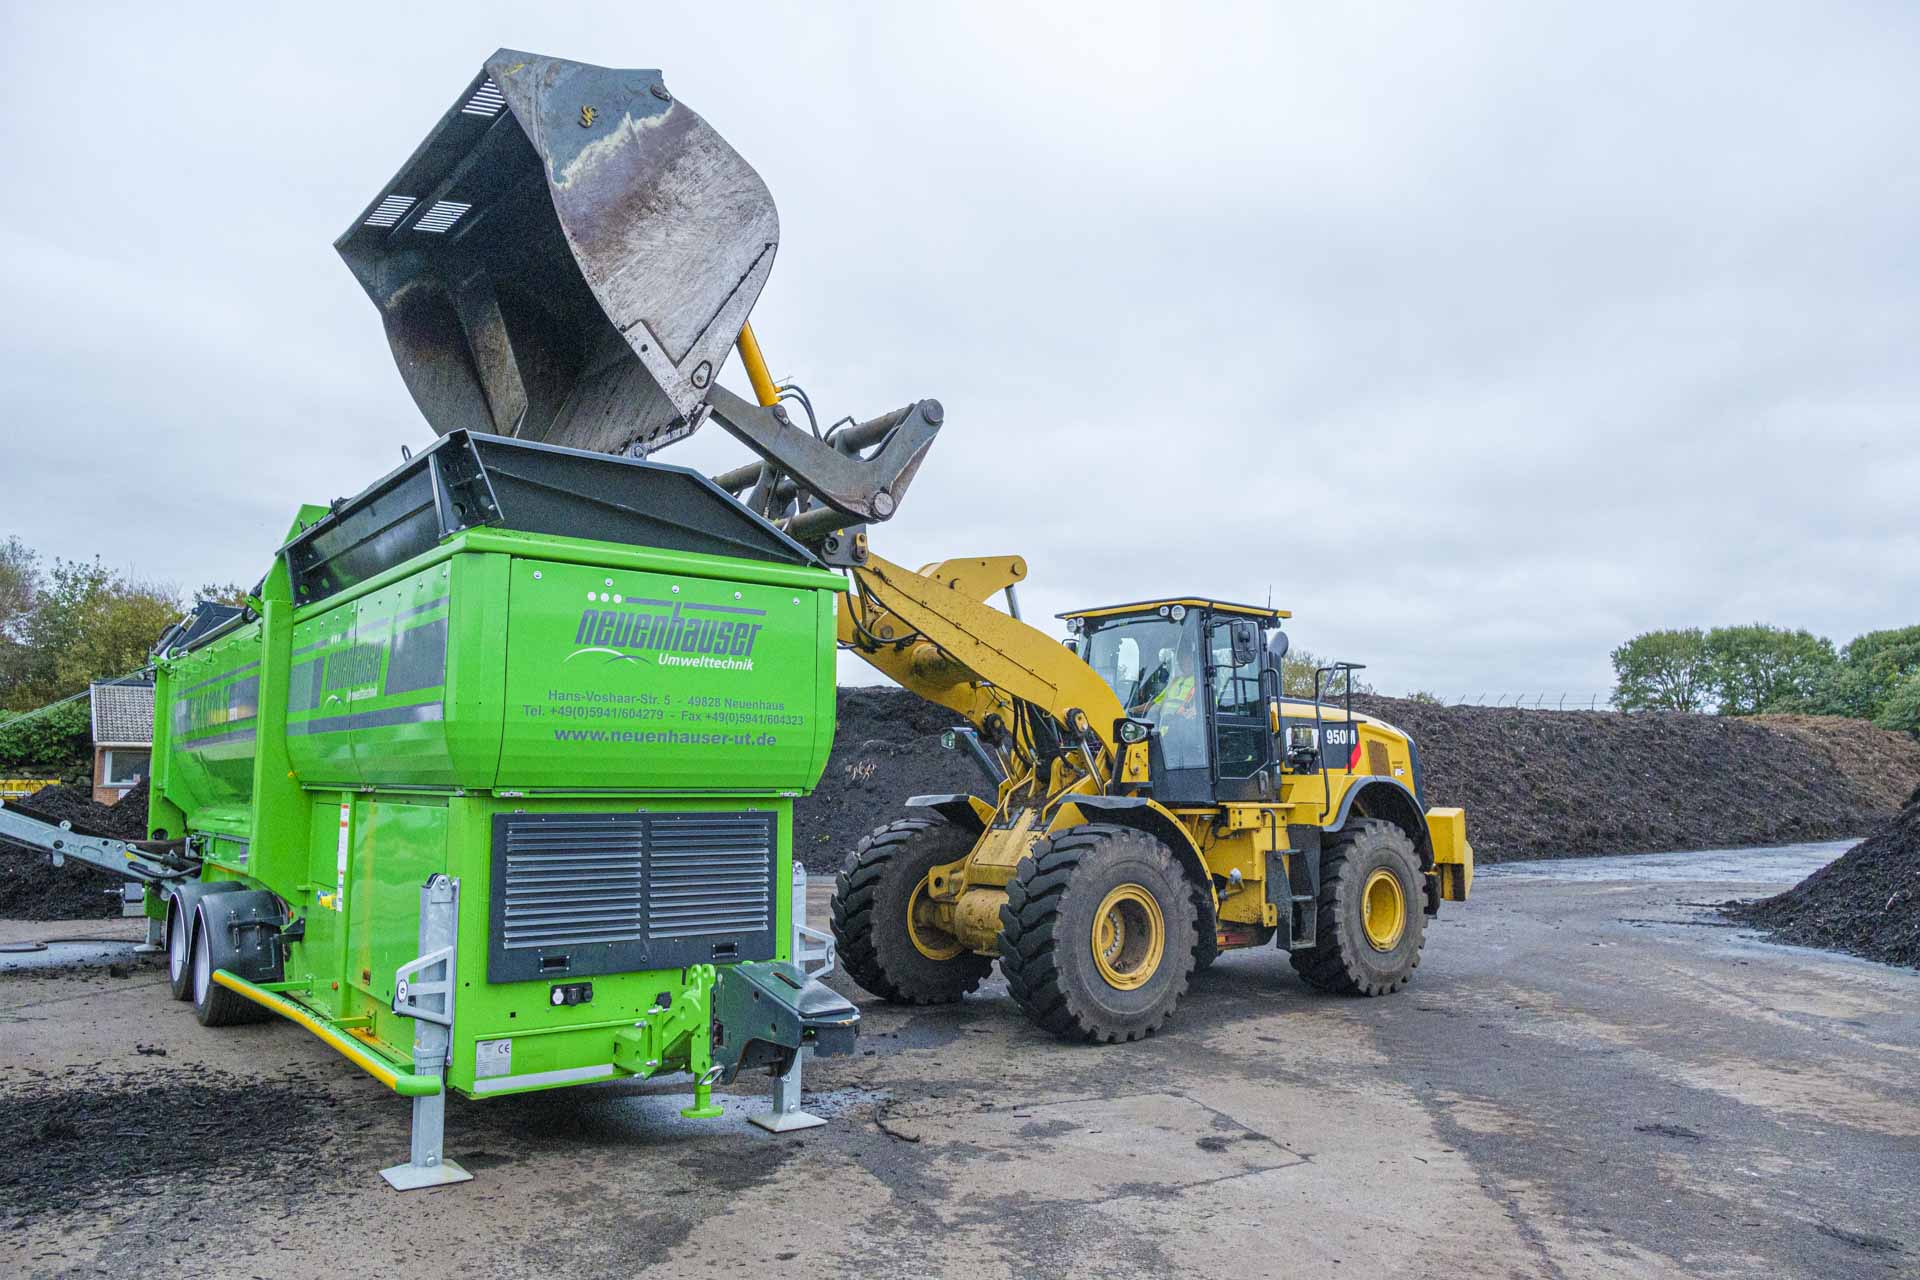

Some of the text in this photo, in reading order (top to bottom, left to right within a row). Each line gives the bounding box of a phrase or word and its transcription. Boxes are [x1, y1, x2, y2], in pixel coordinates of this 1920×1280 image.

[575, 602, 763, 657] neuenhauser
[658, 653, 754, 671] Umwelttechnik
[548, 689, 660, 705] Hans-Voshaar-Str.
[664, 695, 671, 706] 5
[687, 695, 721, 708] 49828
[724, 698, 785, 711] Neuenhaus
[522, 704, 545, 717] Tel.
[550, 705, 664, 720] +49(0)5941/604279
[681, 710, 702, 721] Fax
[554, 728, 777, 746] www.neuenhauser-ut.de
